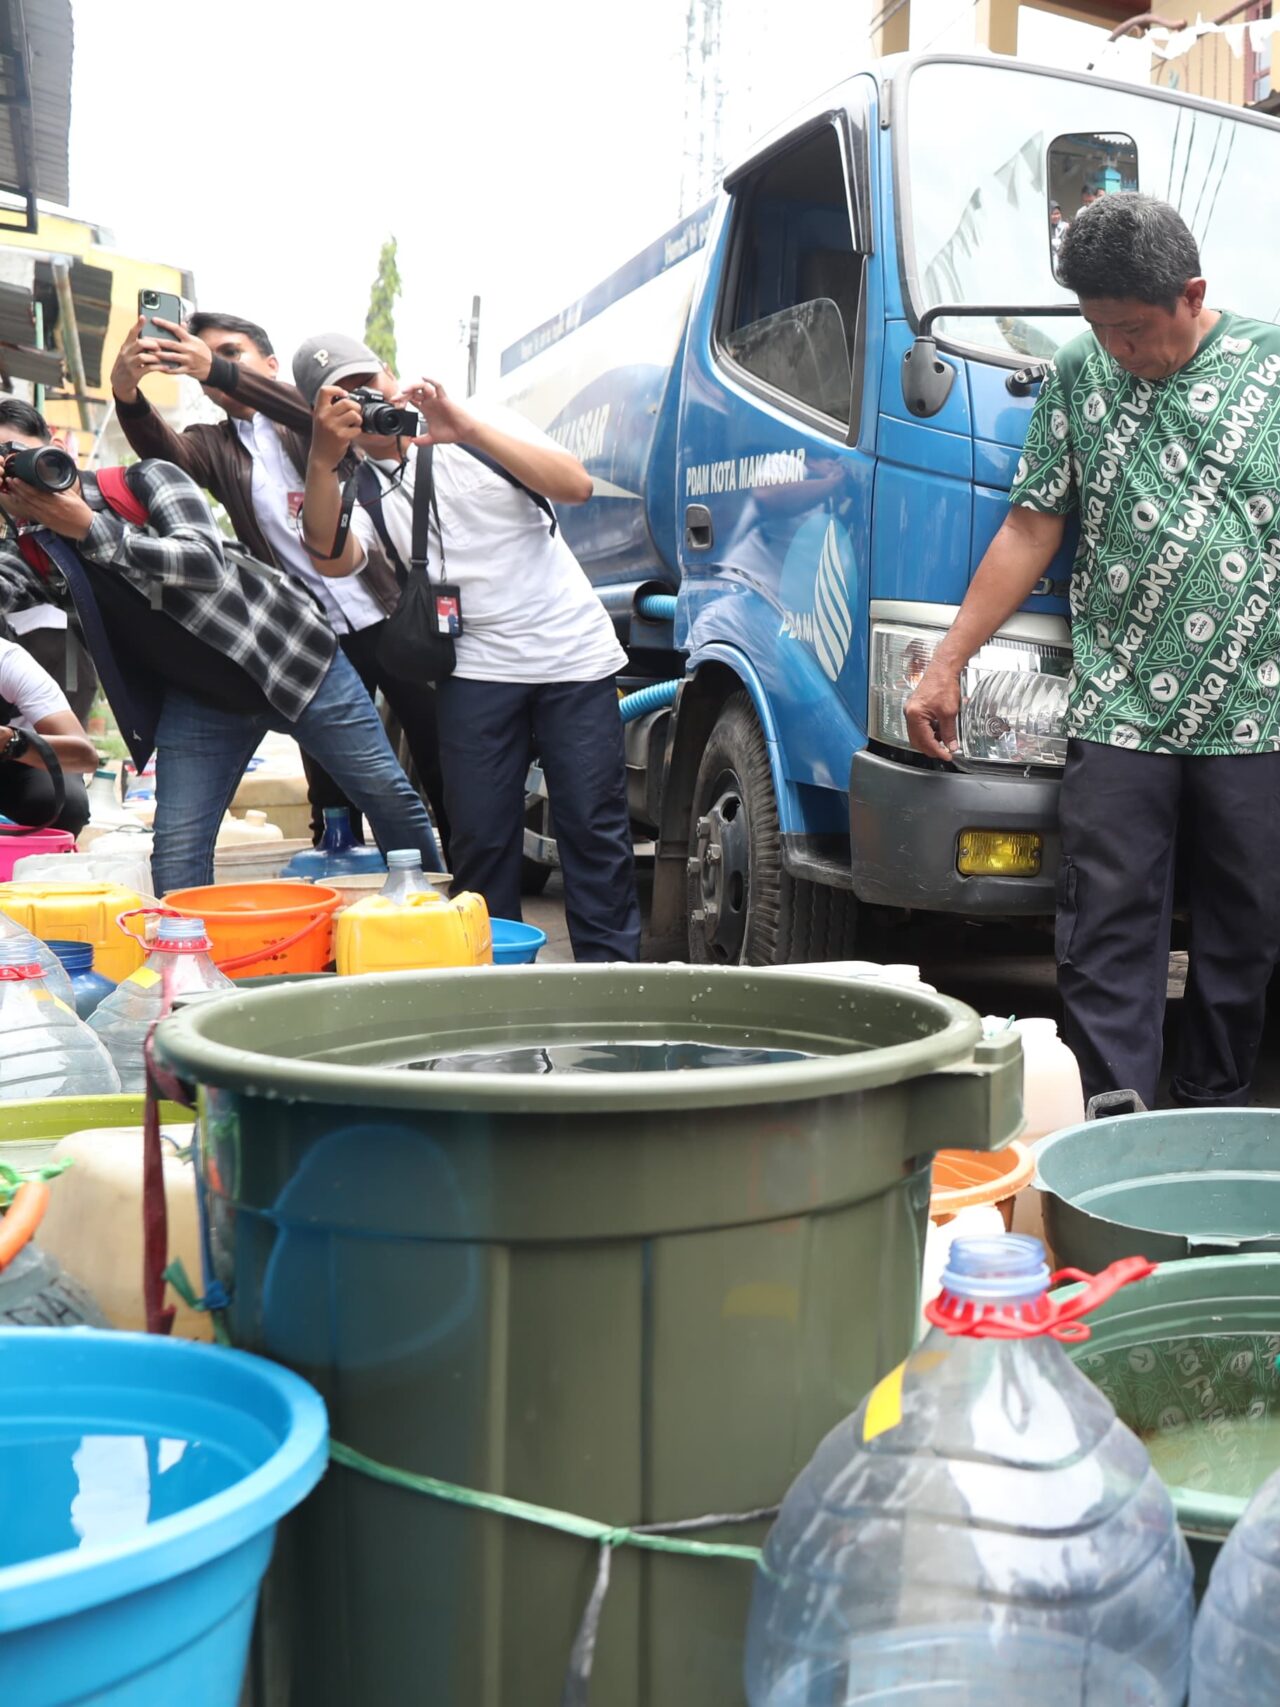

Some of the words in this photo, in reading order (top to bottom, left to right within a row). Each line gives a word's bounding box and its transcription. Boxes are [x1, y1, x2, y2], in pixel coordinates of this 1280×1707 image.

[313, 349, 329, 367] P
[686, 465, 709, 497] PDAM
[710, 460, 737, 493] KOTA
[738, 449, 806, 488] MAKASSAR
